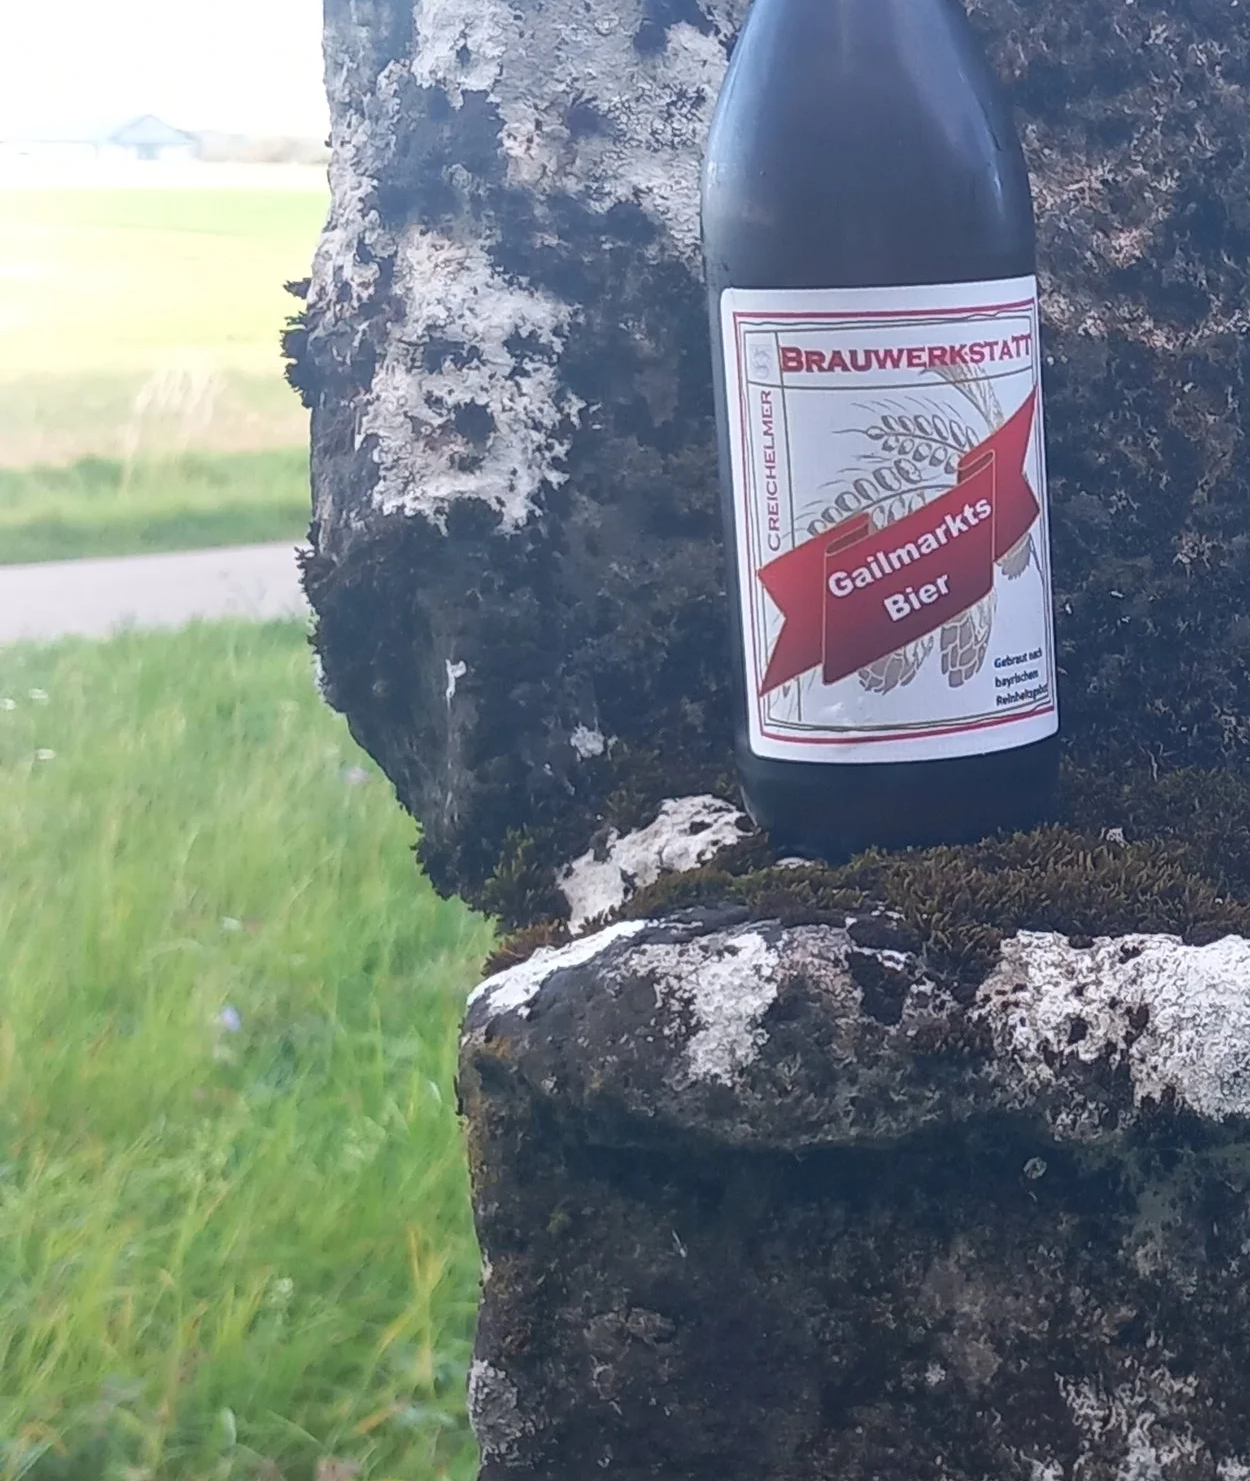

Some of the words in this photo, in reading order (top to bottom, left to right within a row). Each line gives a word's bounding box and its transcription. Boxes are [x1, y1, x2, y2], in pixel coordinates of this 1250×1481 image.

[780, 332, 1032, 372] BRAUWERKSTATT
[761, 389, 782, 552] CREICHELMER
[828, 495, 993, 599] Gailmarkts
[883, 572, 951, 623] Bier
